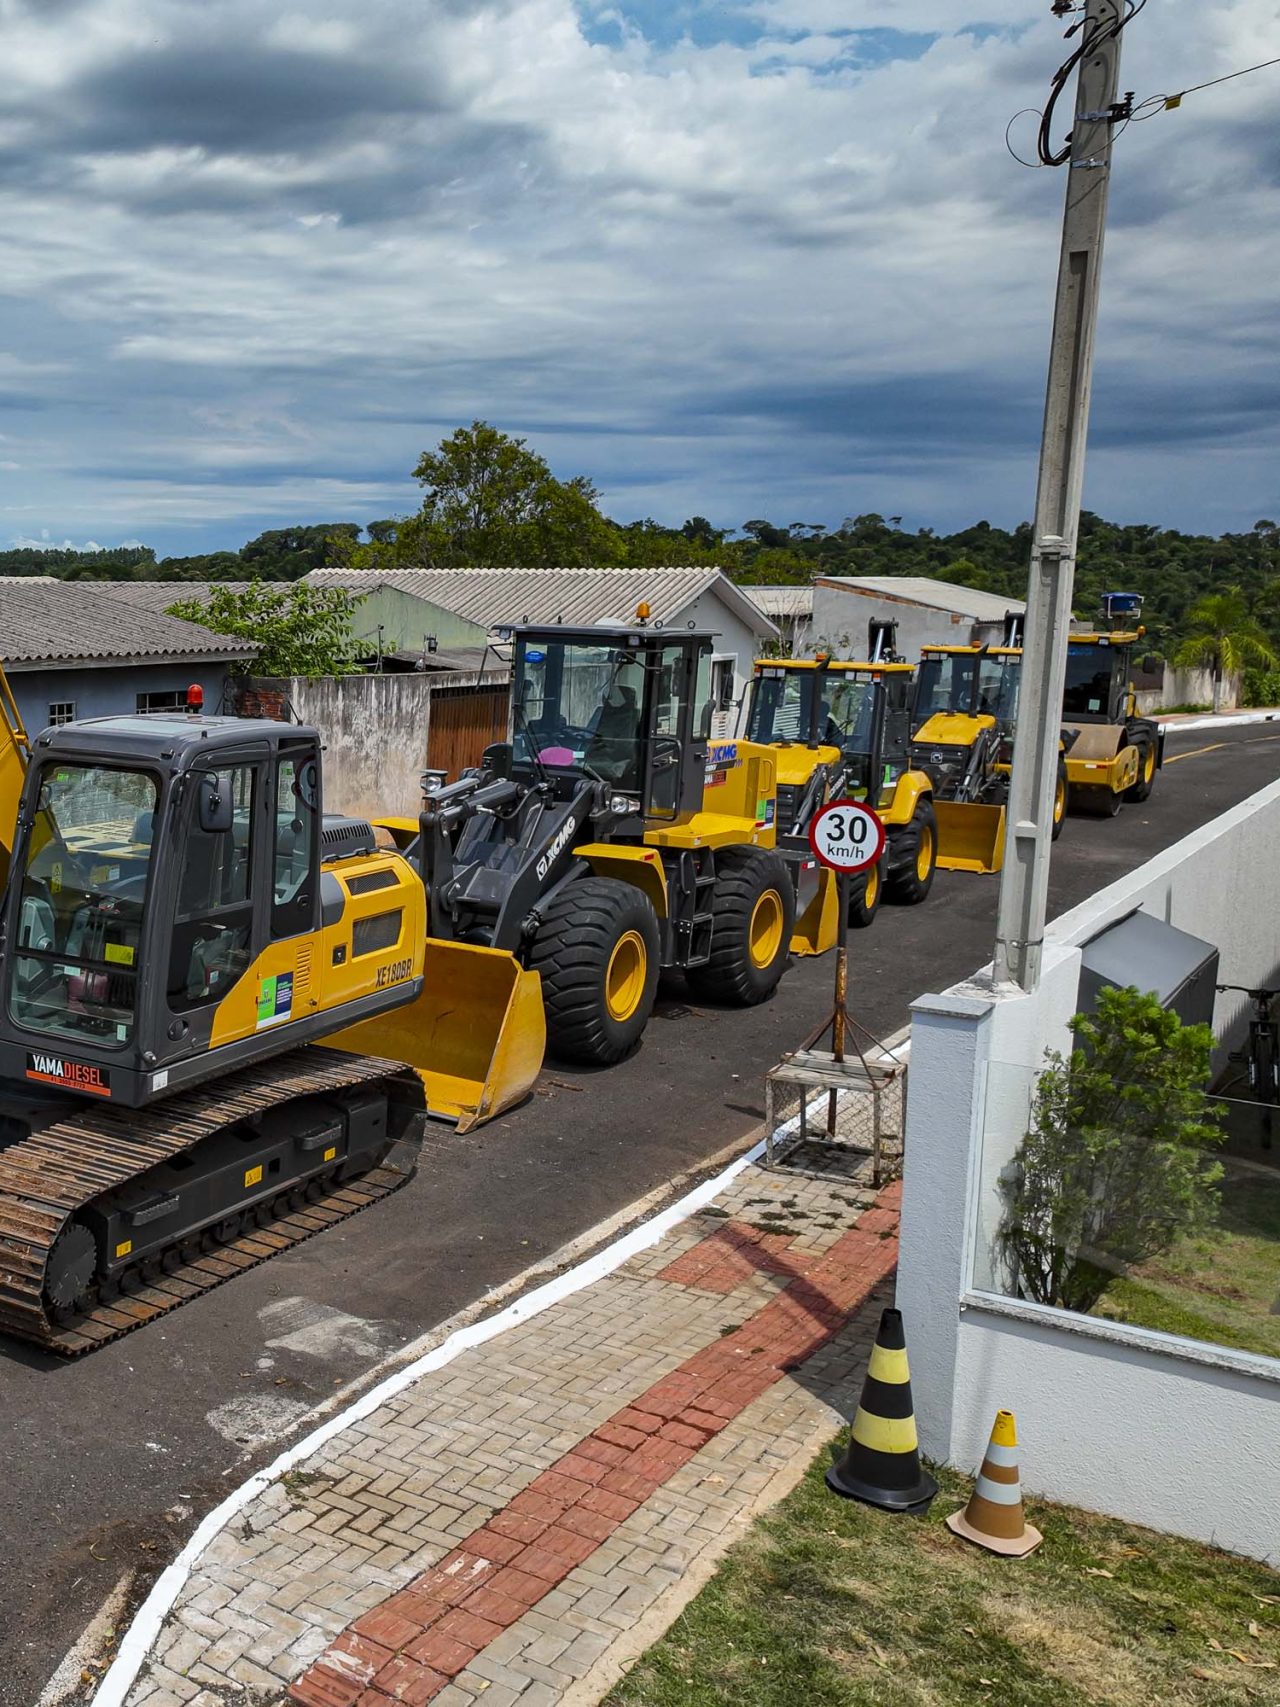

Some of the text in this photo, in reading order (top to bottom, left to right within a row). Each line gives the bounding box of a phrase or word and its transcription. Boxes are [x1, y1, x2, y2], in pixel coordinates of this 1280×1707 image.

[546, 815, 576, 870] XCMG
[826, 813, 868, 845] 30
[827, 843, 865, 859] km/h
